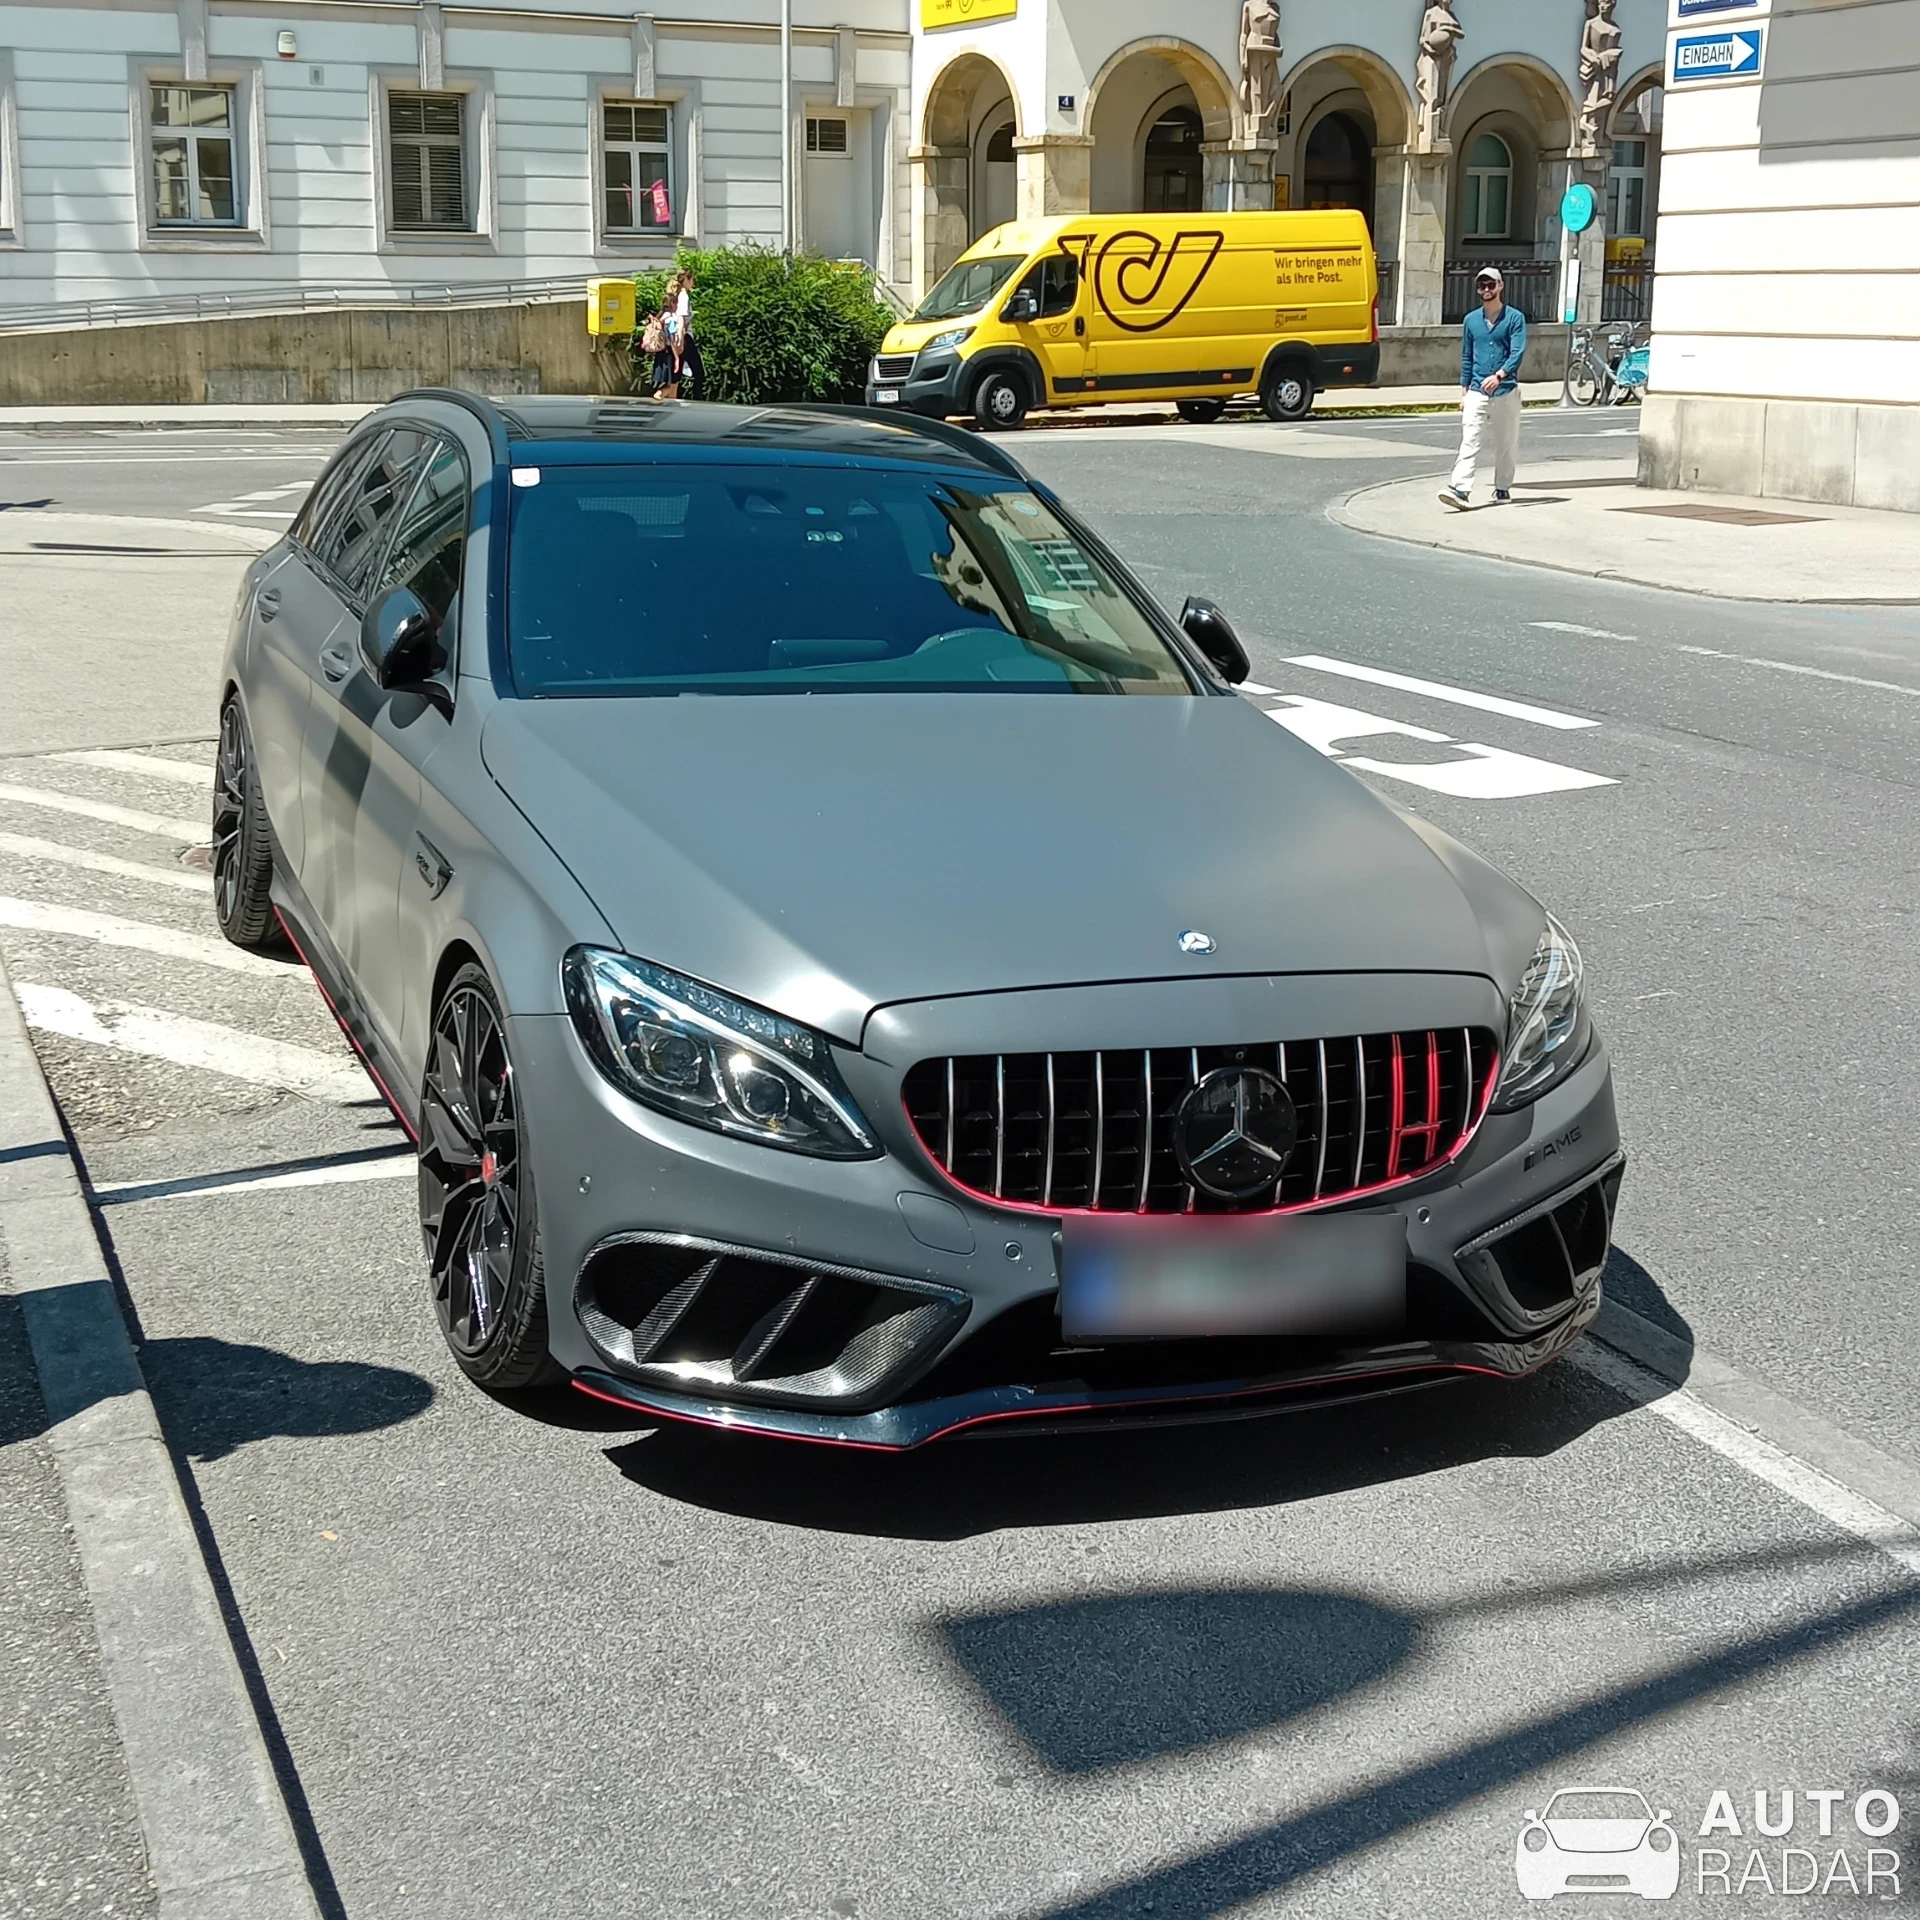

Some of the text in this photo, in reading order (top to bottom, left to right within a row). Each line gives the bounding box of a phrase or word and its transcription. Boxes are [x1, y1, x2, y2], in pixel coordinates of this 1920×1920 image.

[1683, 44, 1733, 65] EINBAHN
[1274, 255, 1362, 270] Wir bringen mehr
[1276, 271, 1343, 284] als Ihre Post.
[1543, 1126, 1582, 1161] AMG
